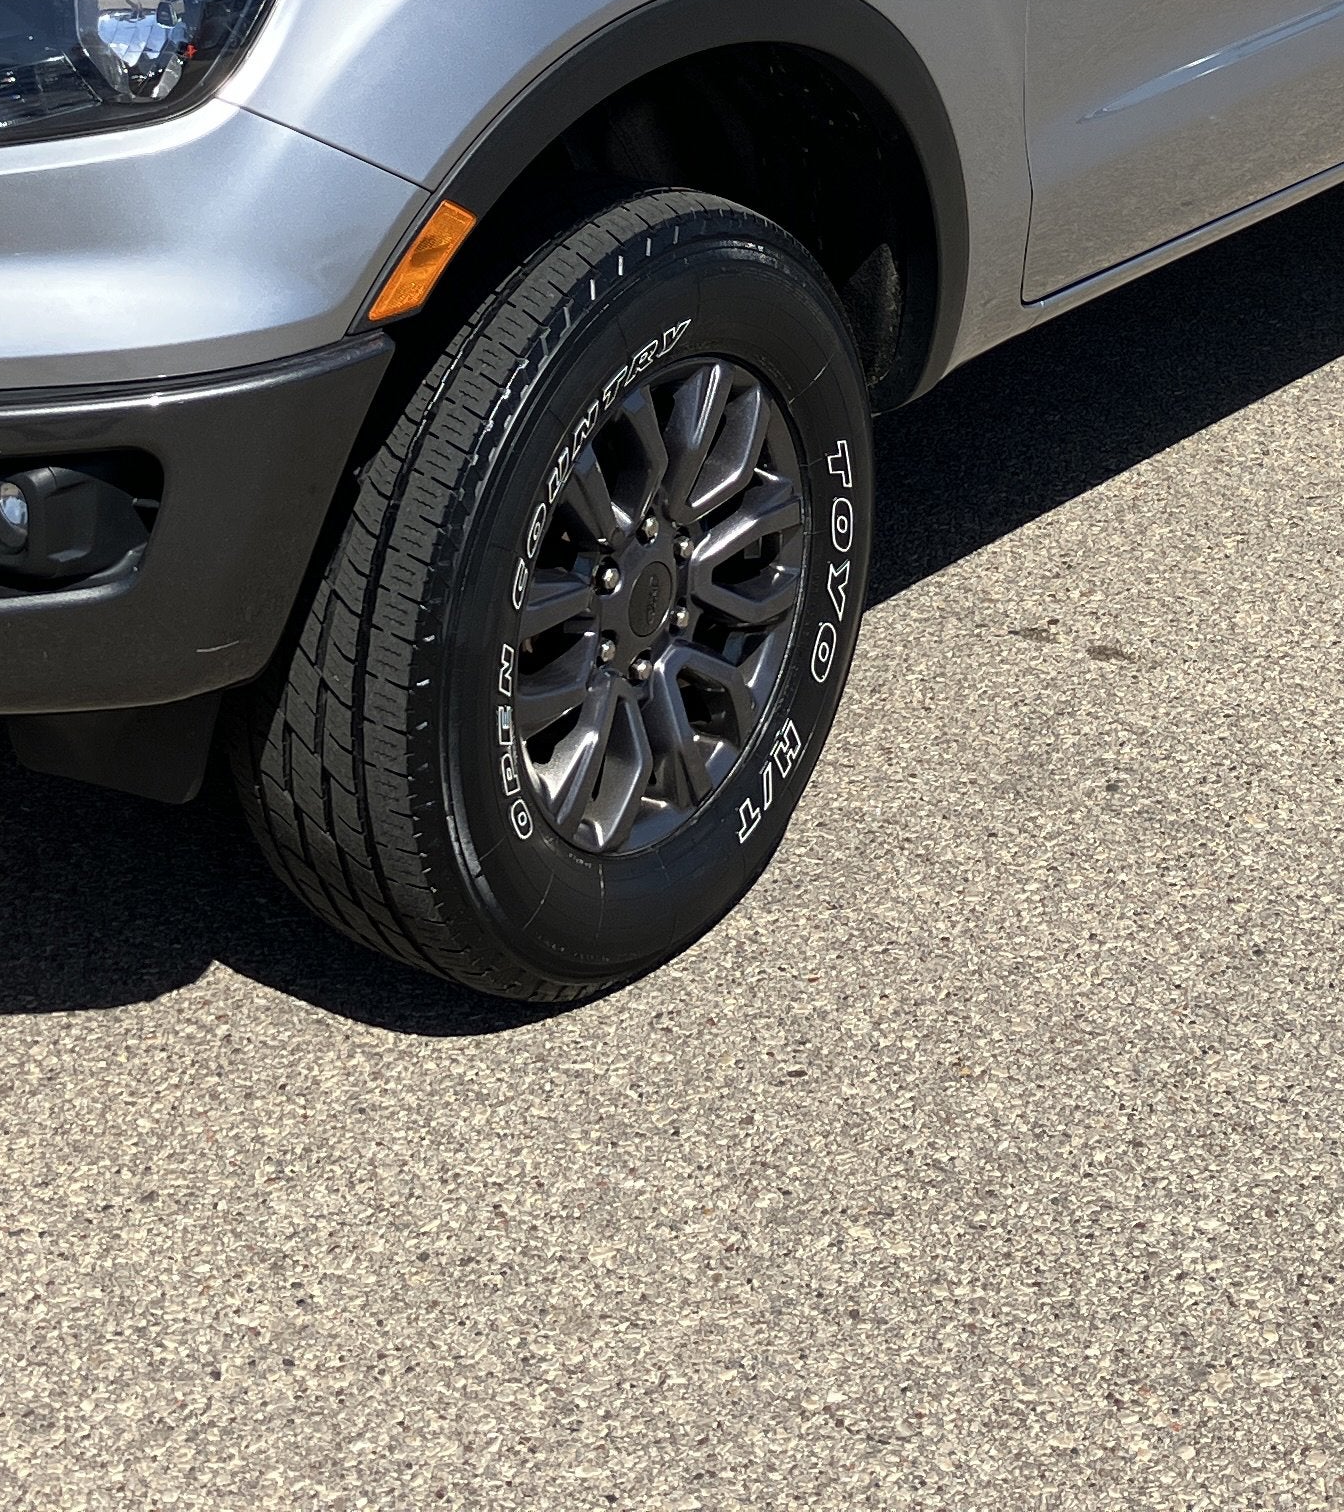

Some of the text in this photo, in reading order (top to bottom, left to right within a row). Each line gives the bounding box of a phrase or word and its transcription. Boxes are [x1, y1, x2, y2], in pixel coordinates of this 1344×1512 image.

[496, 318, 692, 840] OPEN COUNTRY
[736, 439, 855, 844] TOYO H/T
